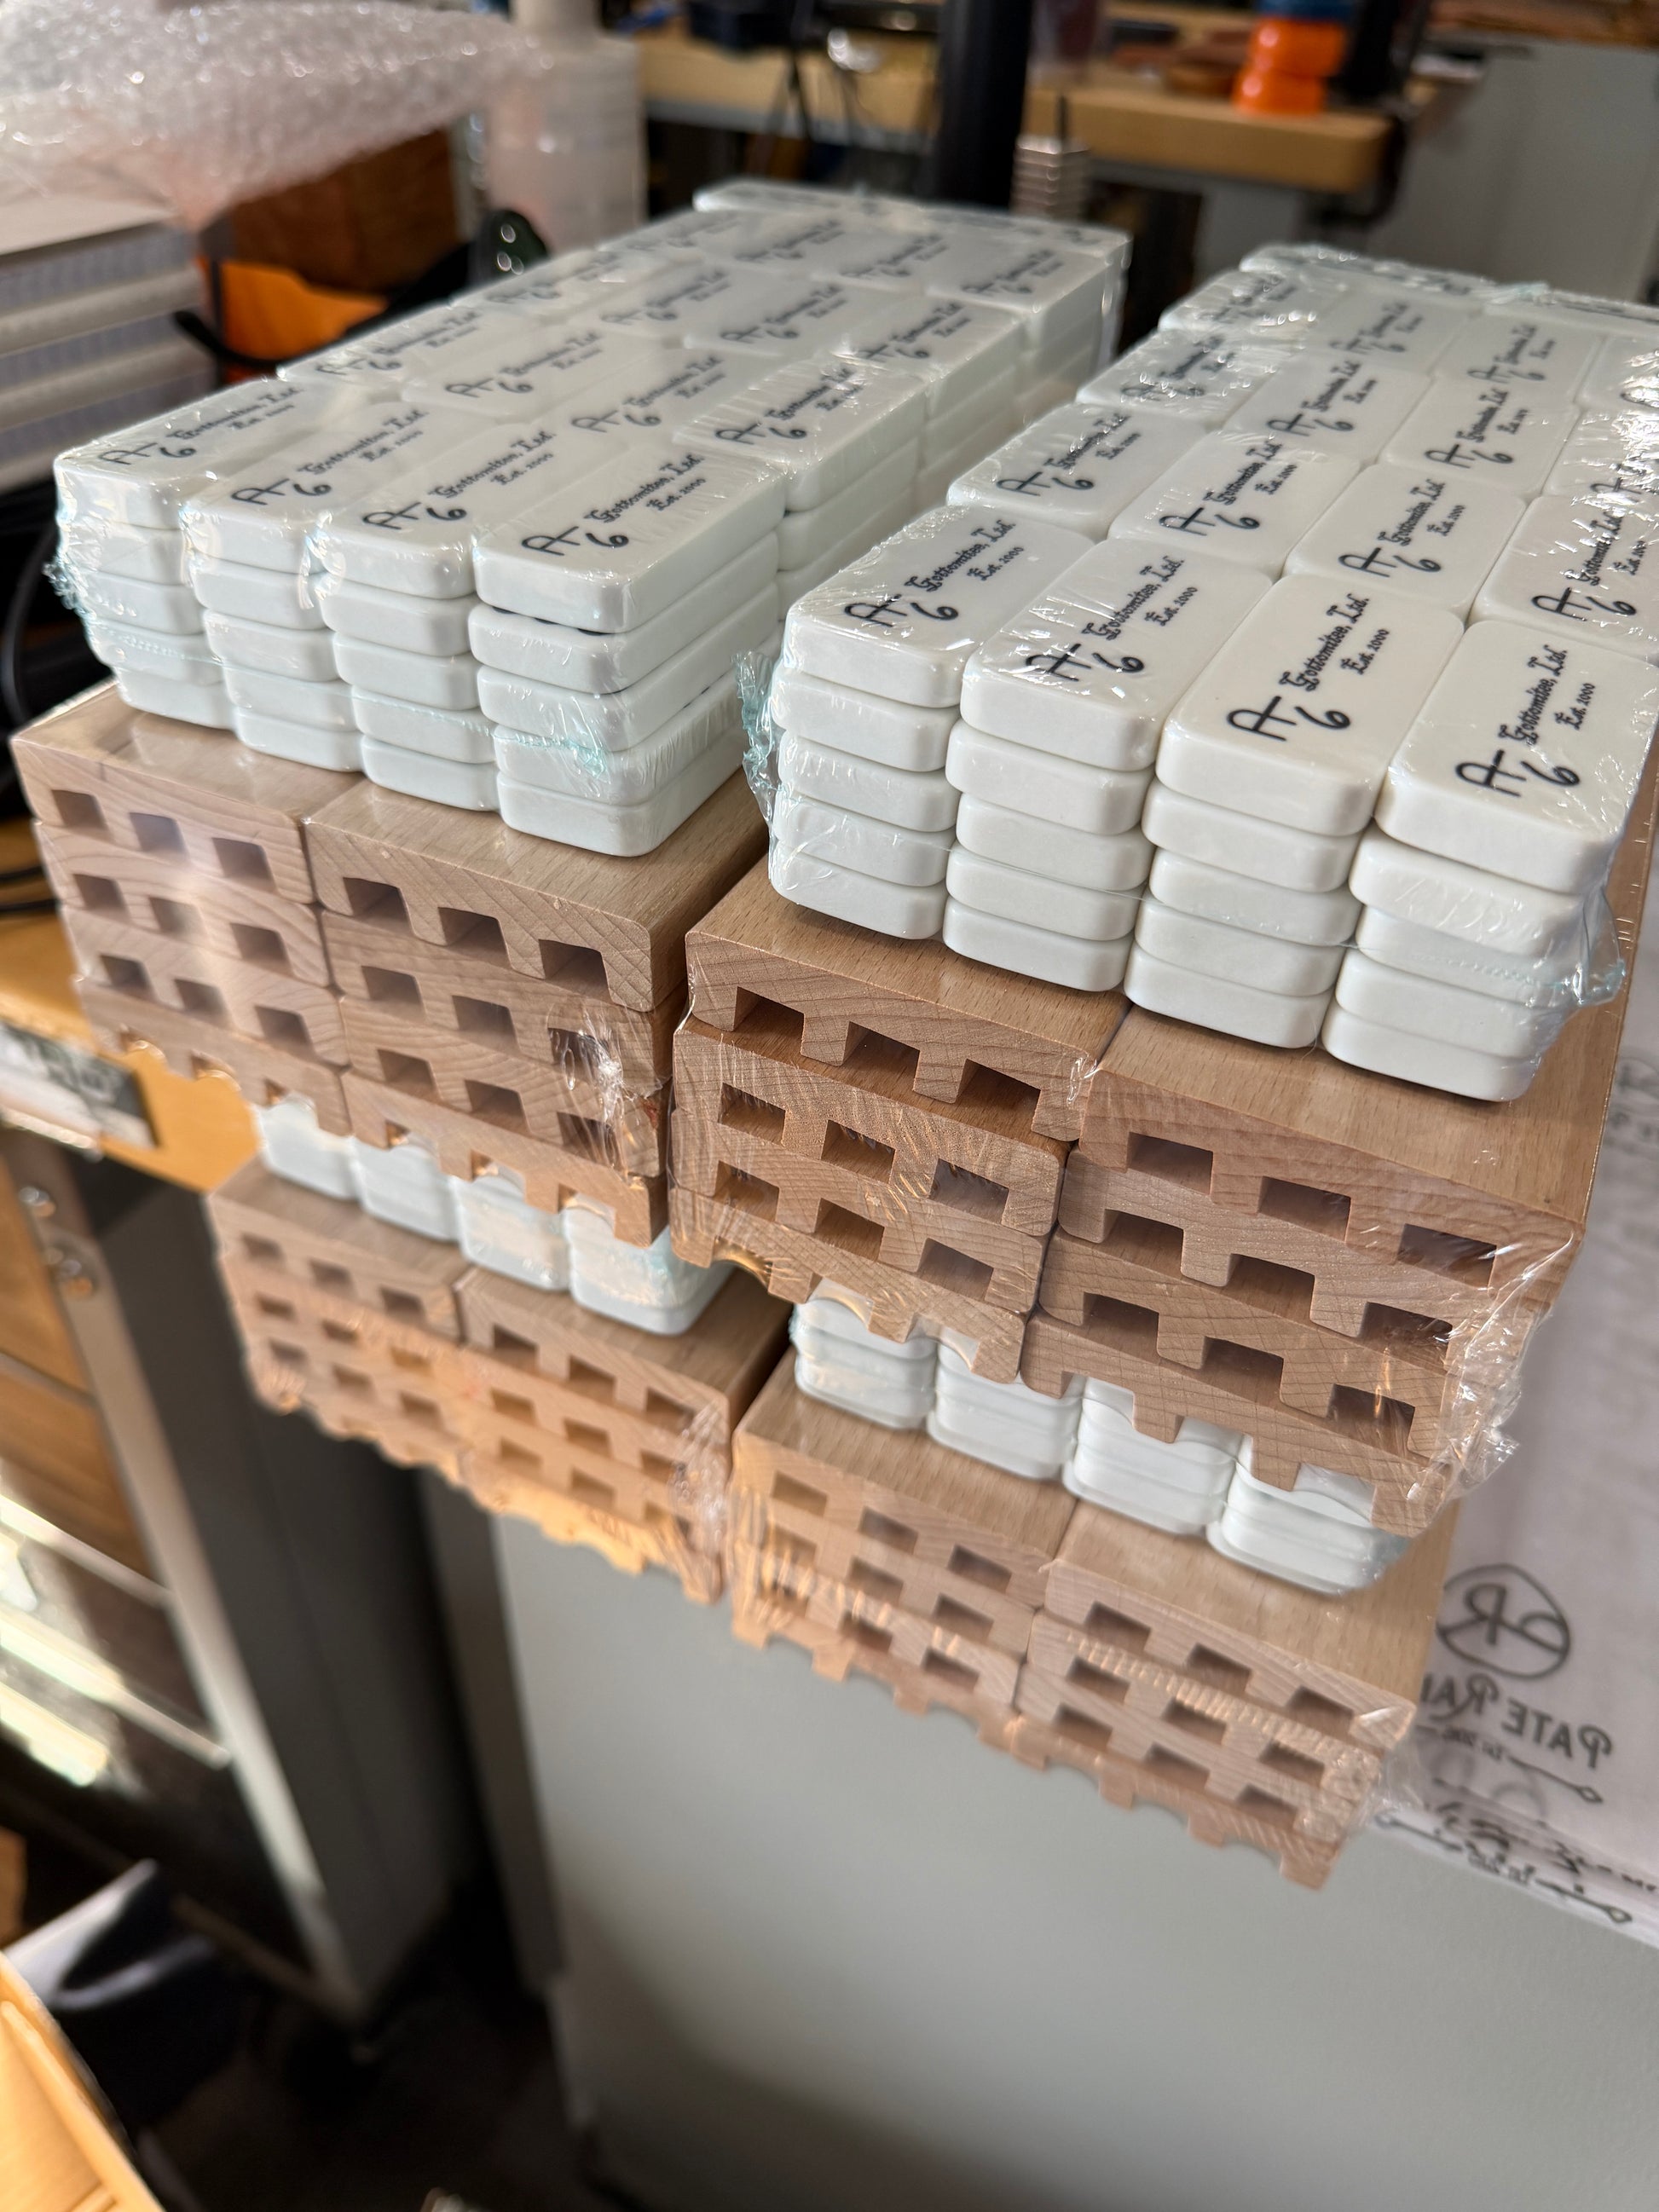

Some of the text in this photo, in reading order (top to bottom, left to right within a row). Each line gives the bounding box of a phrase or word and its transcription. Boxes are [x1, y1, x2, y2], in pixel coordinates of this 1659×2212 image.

[230, 478, 332, 506] A 6
[996, 471, 1095, 497] A 6
[362, 501, 467, 530] A 6
[1159, 506, 1261, 537] A 6
[521, 525, 629, 557] A 6
[1338, 546, 1442, 578] A 6
[844, 594, 959, 627] A 6
[1531, 586, 1637, 621] A 6
[1026, 644, 1145, 682] A 6
[1340, 628, 1390, 675] Est. 2000
[1226, 696, 1351, 742] A 6
[1554, 683, 1596, 731] Est. 2000
[1454, 748, 1581, 798] A 6
